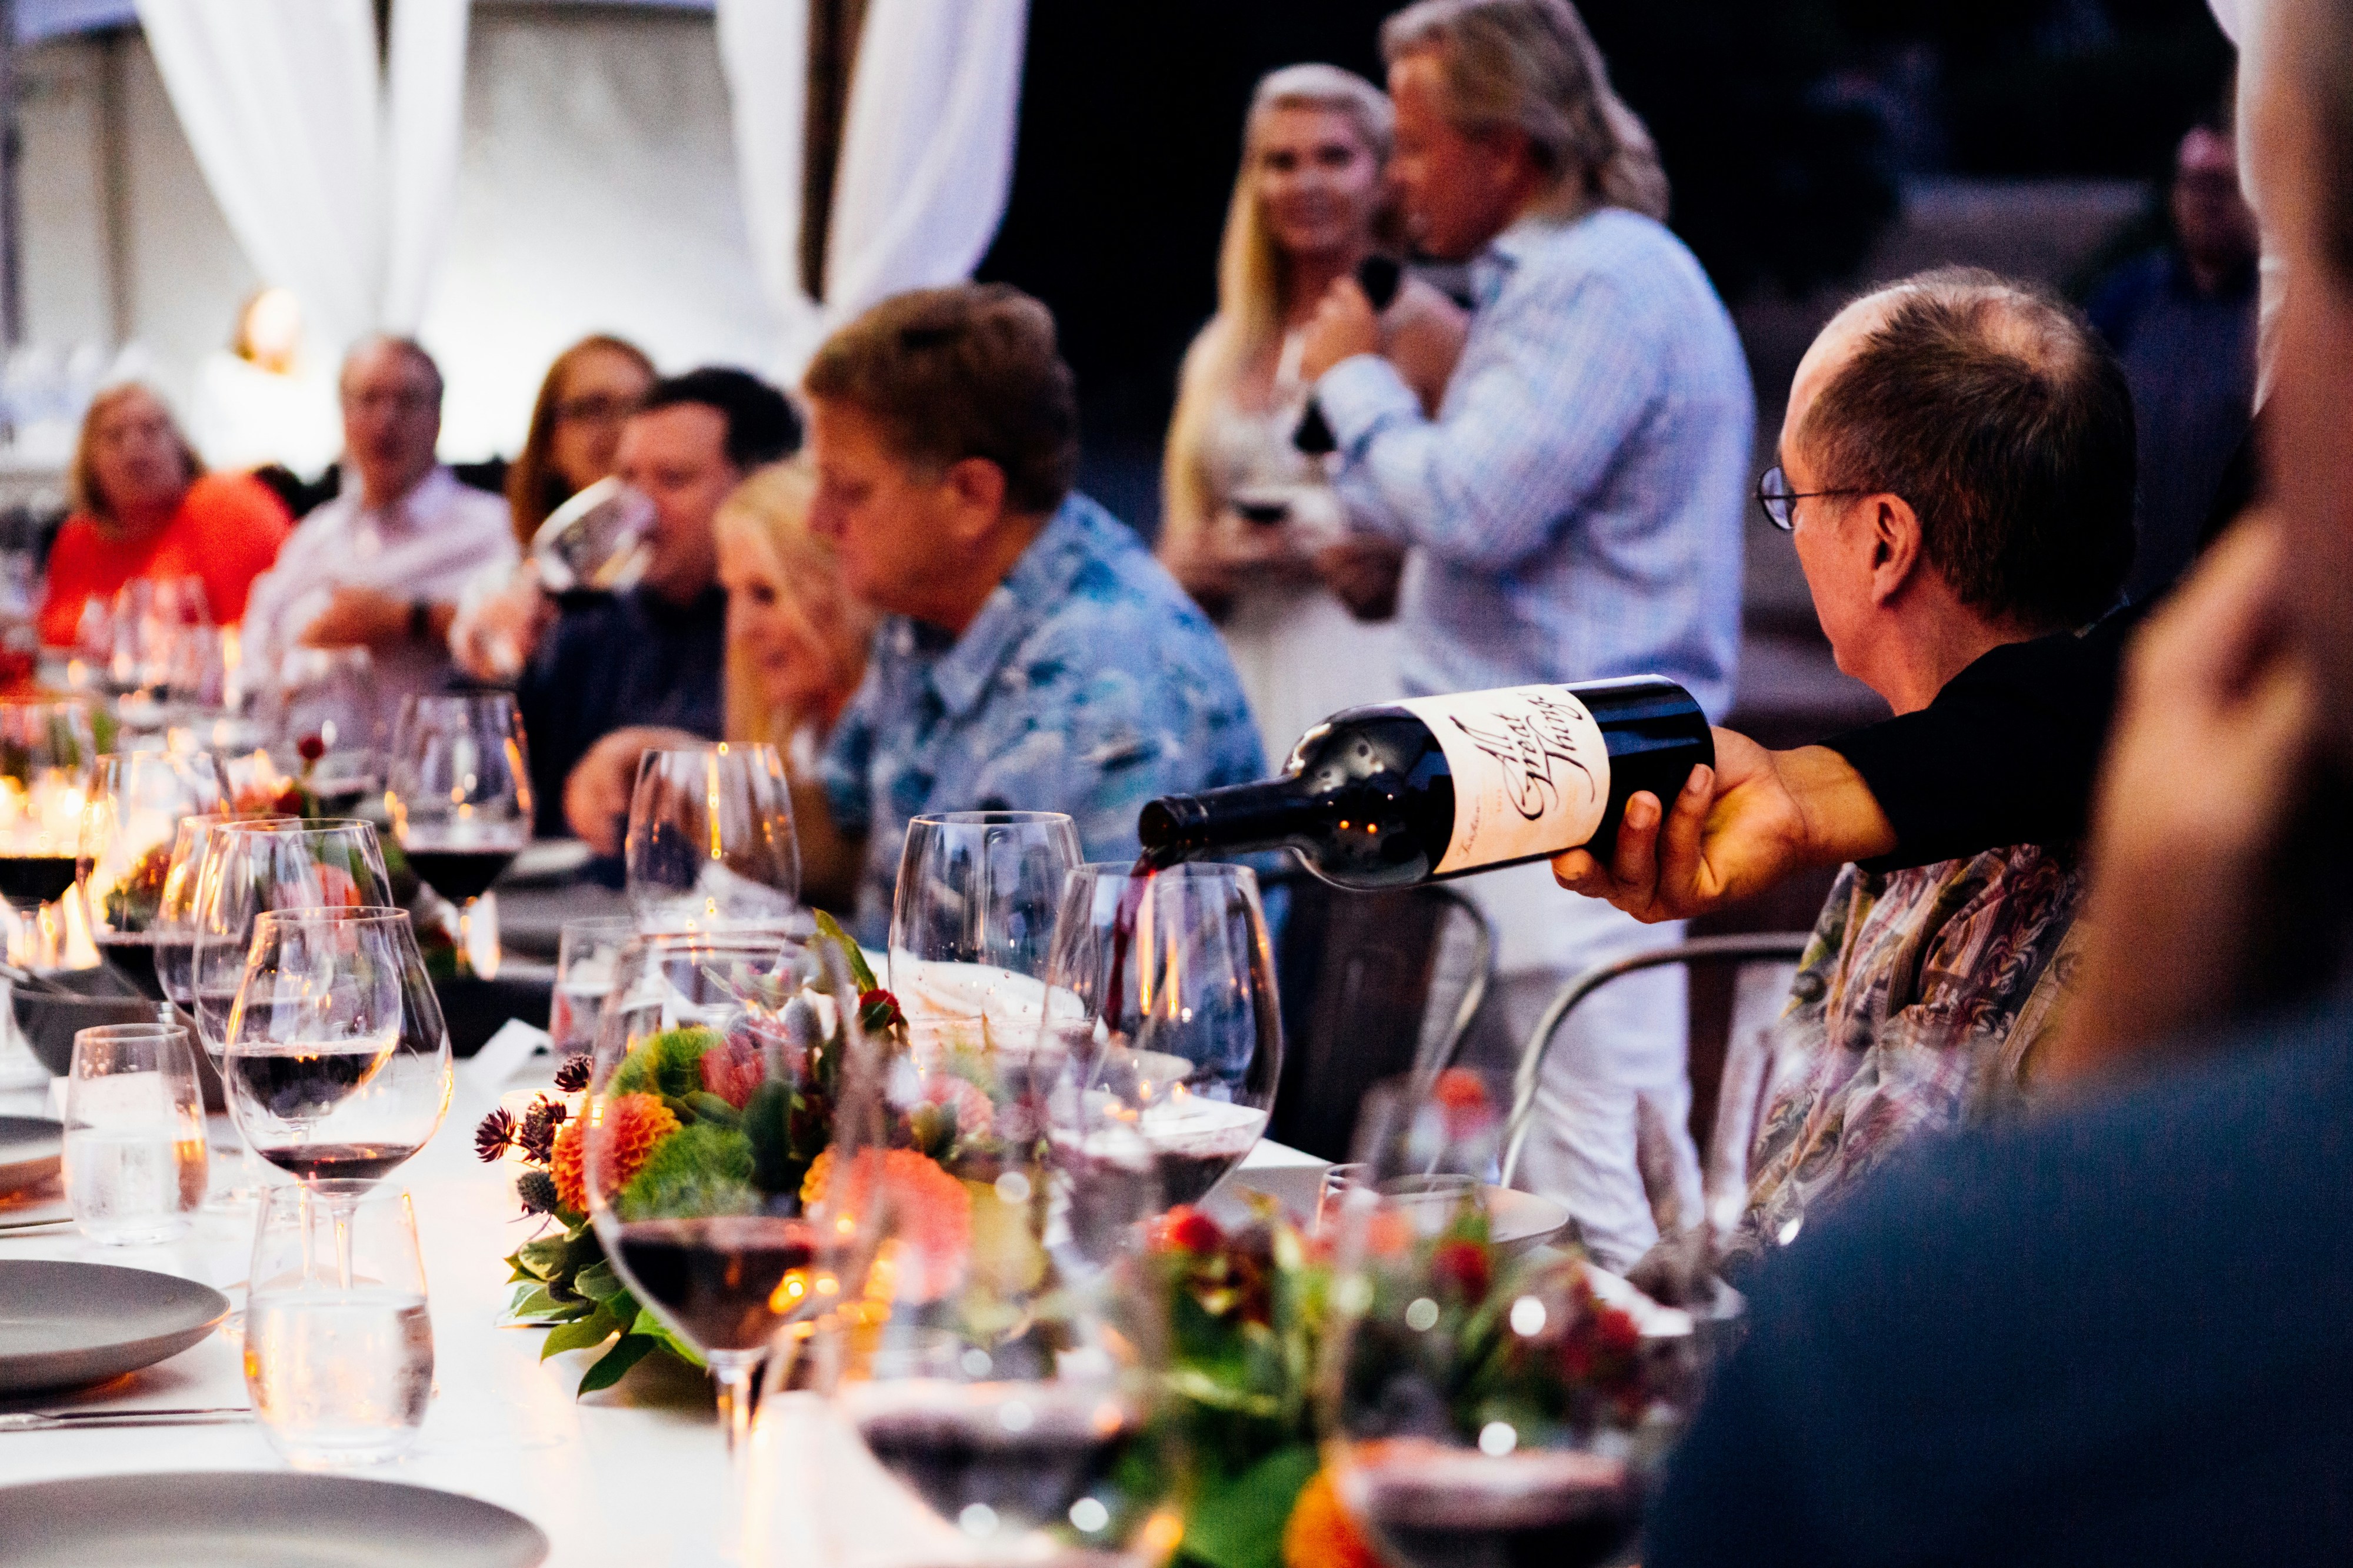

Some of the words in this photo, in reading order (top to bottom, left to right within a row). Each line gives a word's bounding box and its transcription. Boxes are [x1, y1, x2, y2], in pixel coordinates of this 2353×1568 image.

[1448, 714, 1527, 806] All
[1491, 712, 1559, 821] Great
[1518, 693, 1596, 803] Things
